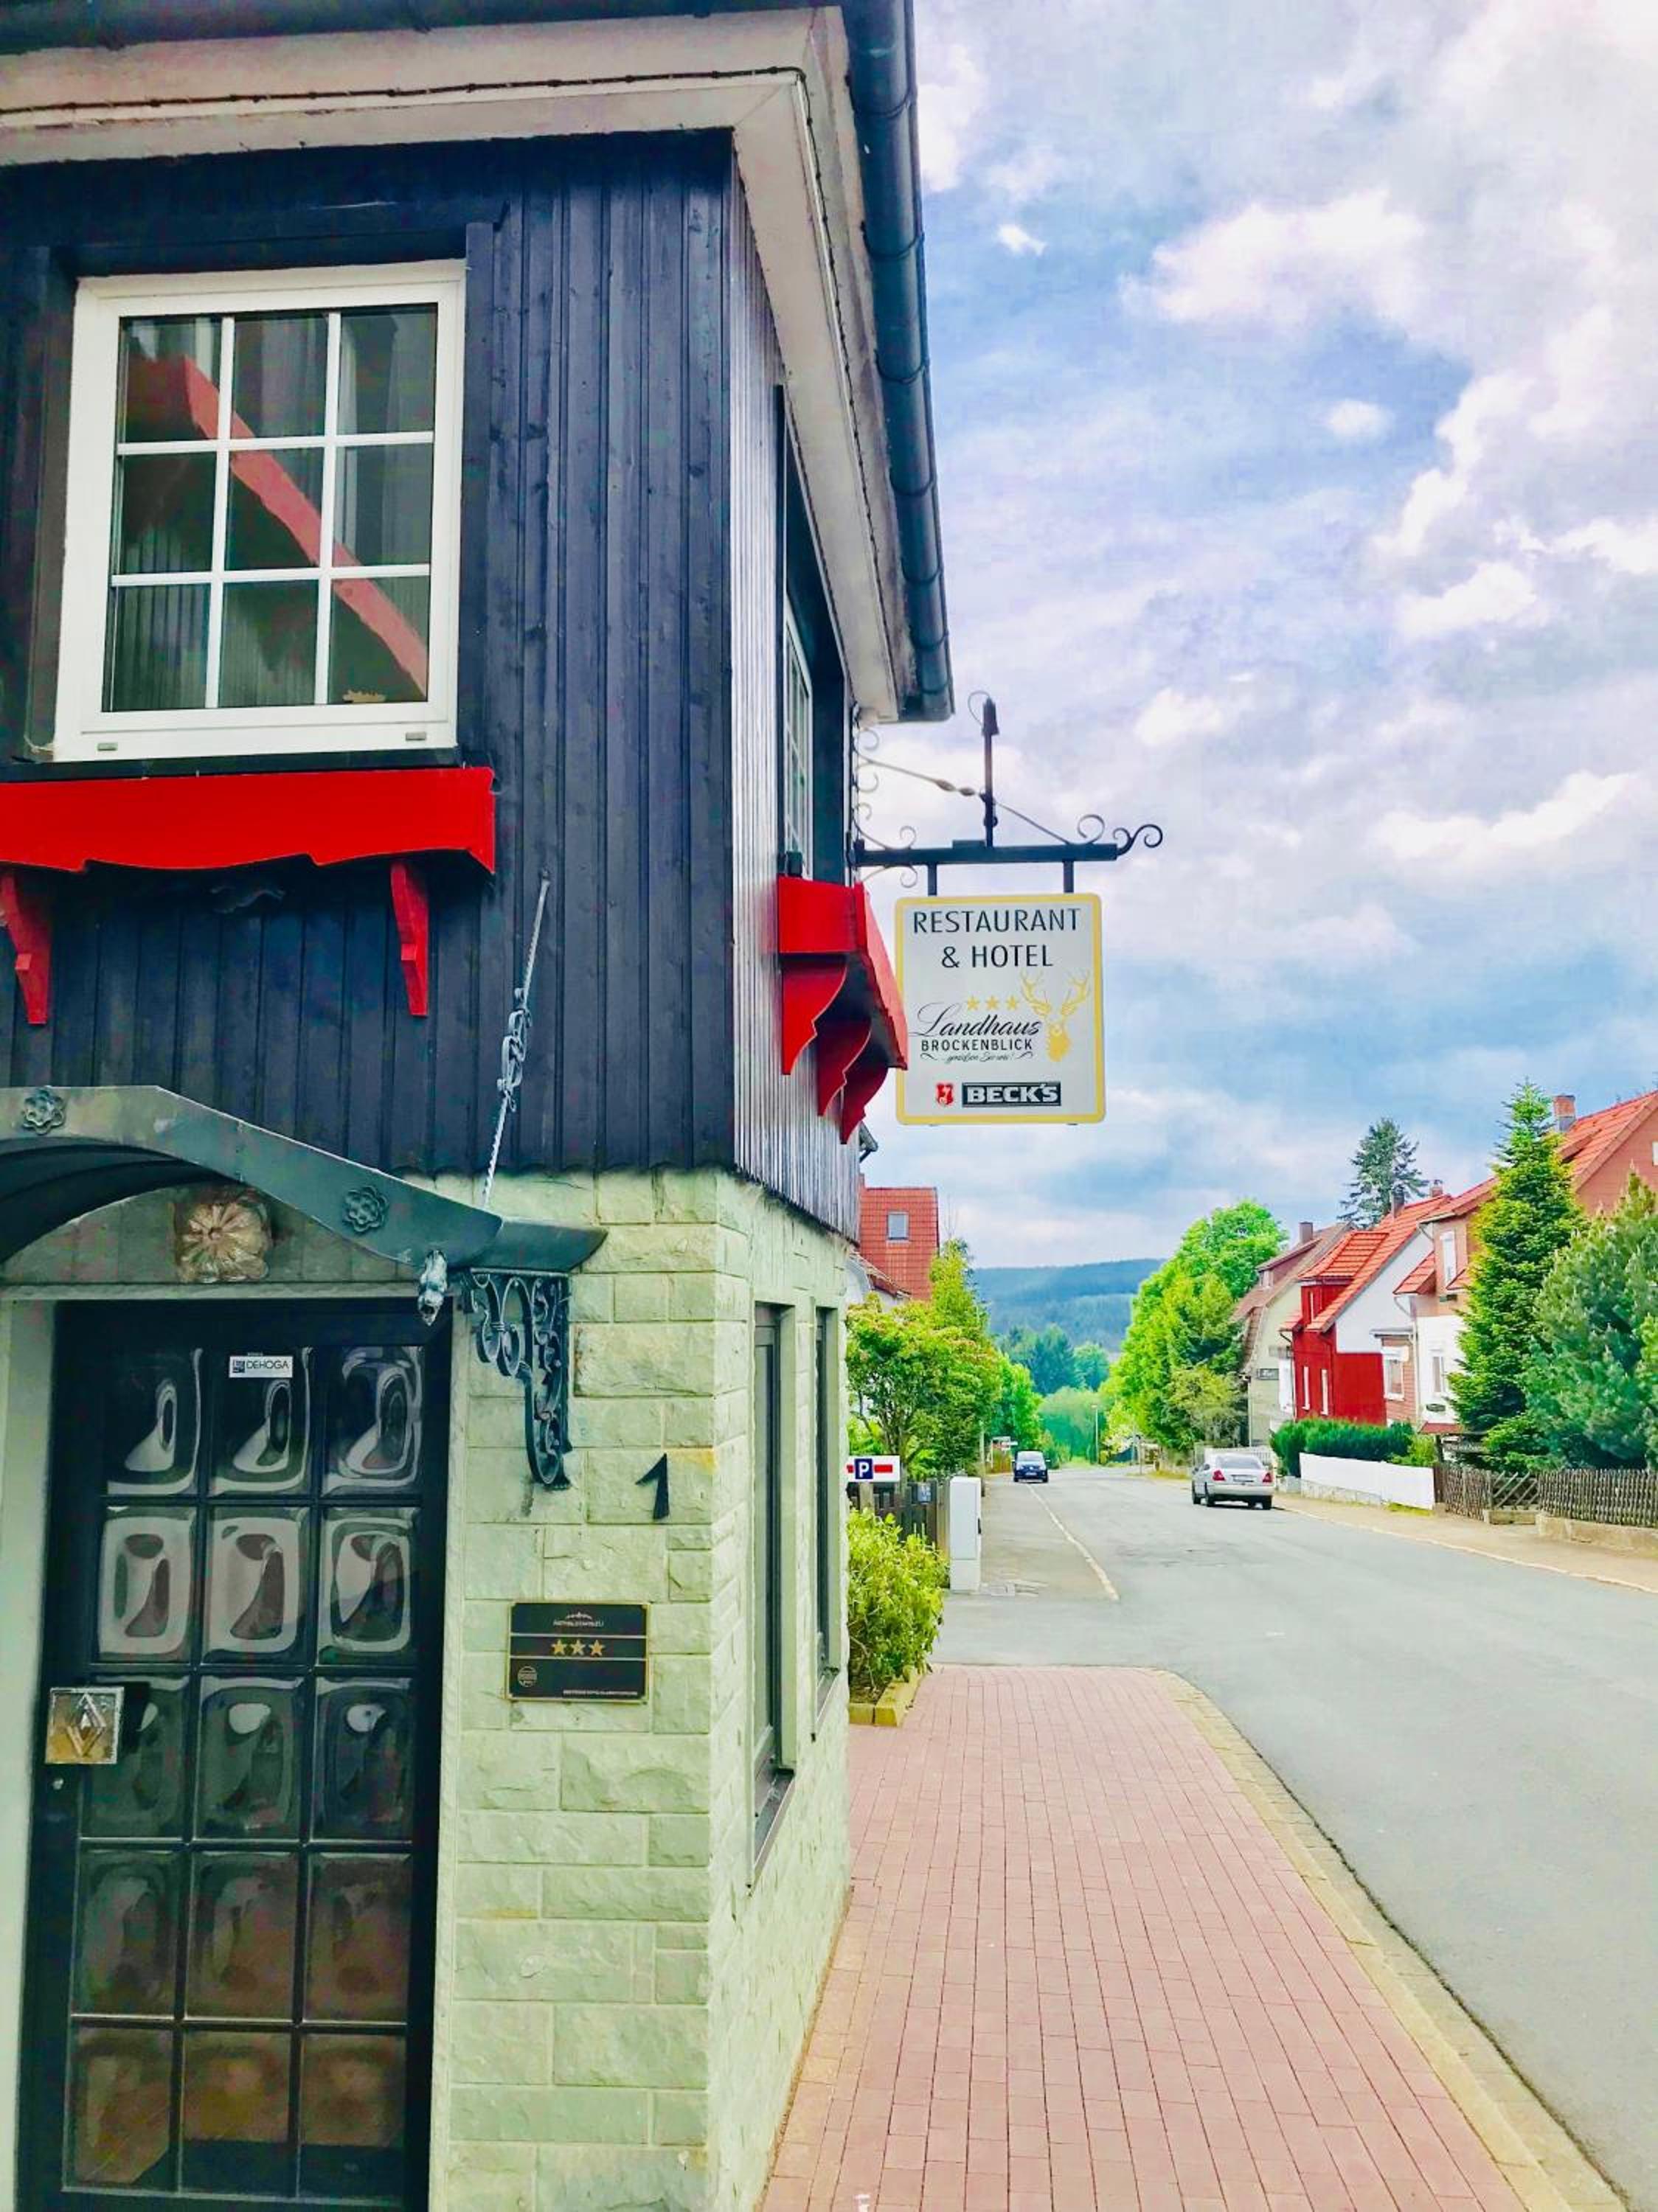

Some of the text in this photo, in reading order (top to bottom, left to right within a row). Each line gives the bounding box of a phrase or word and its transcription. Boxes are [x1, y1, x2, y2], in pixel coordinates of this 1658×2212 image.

[913, 908, 1081, 933] RESTAURANT
[941, 945, 1054, 968] & HOTEL
[909, 1001, 1042, 1037] Landhaus
[921, 1039, 1033, 1052] BROCKENBLICK
[966, 1084, 1059, 1103] BECK'S
[246, 1360, 290, 1369] DEHOGA
[859, 1461, 870, 1478] P
